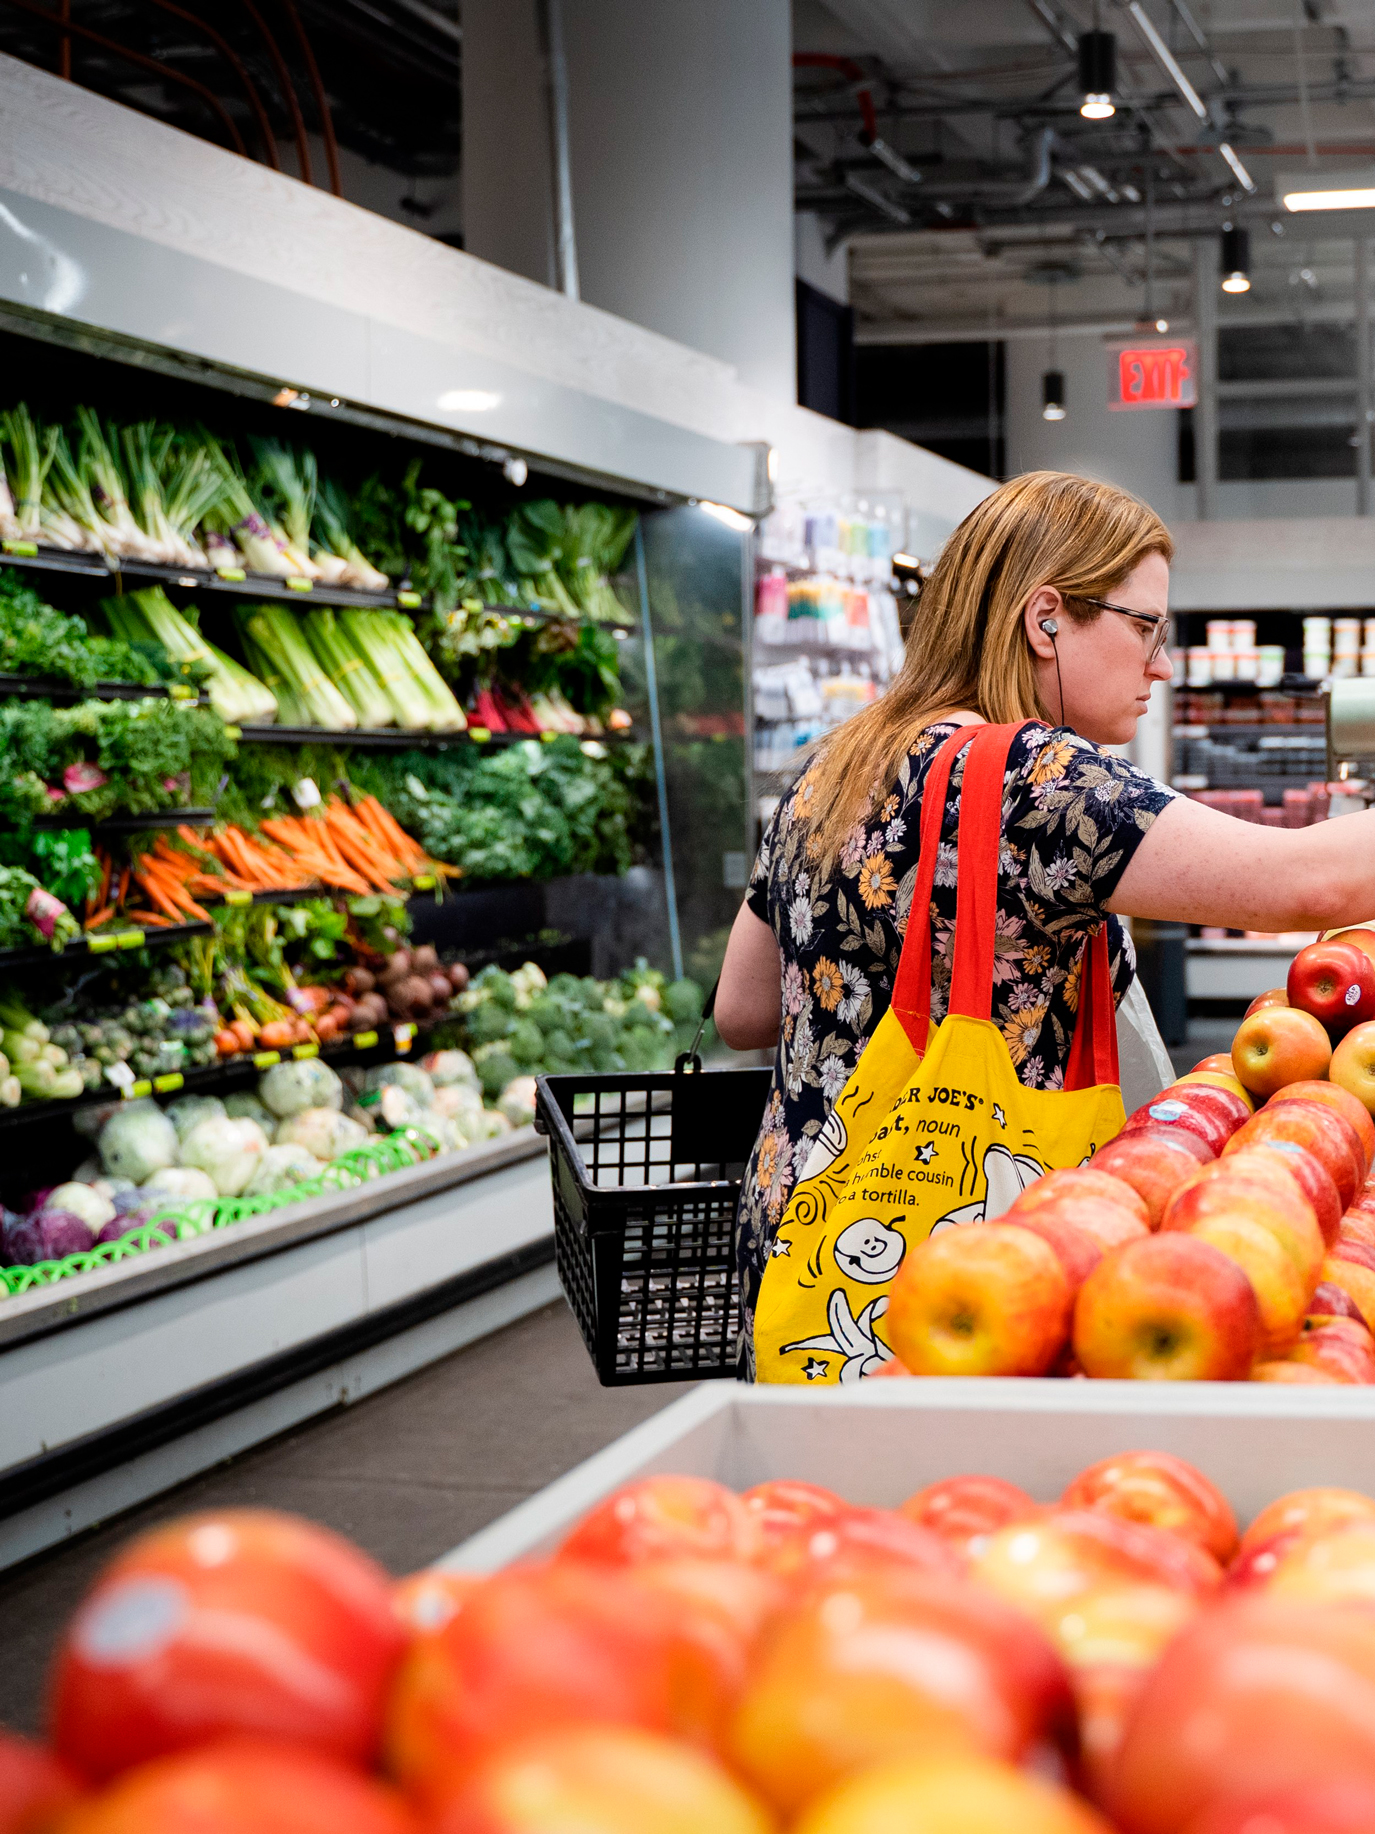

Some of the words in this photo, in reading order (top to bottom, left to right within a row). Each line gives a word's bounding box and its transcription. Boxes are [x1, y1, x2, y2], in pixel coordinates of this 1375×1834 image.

[1120, 348, 1187, 402] EXIT
[927, 1087, 978, 1111] JOE'S
[916, 1119, 961, 1138] noun
[907, 1170, 954, 1188] cousin
[848, 1191, 856, 1201] a
[862, 1188, 919, 1206] tortilla.
